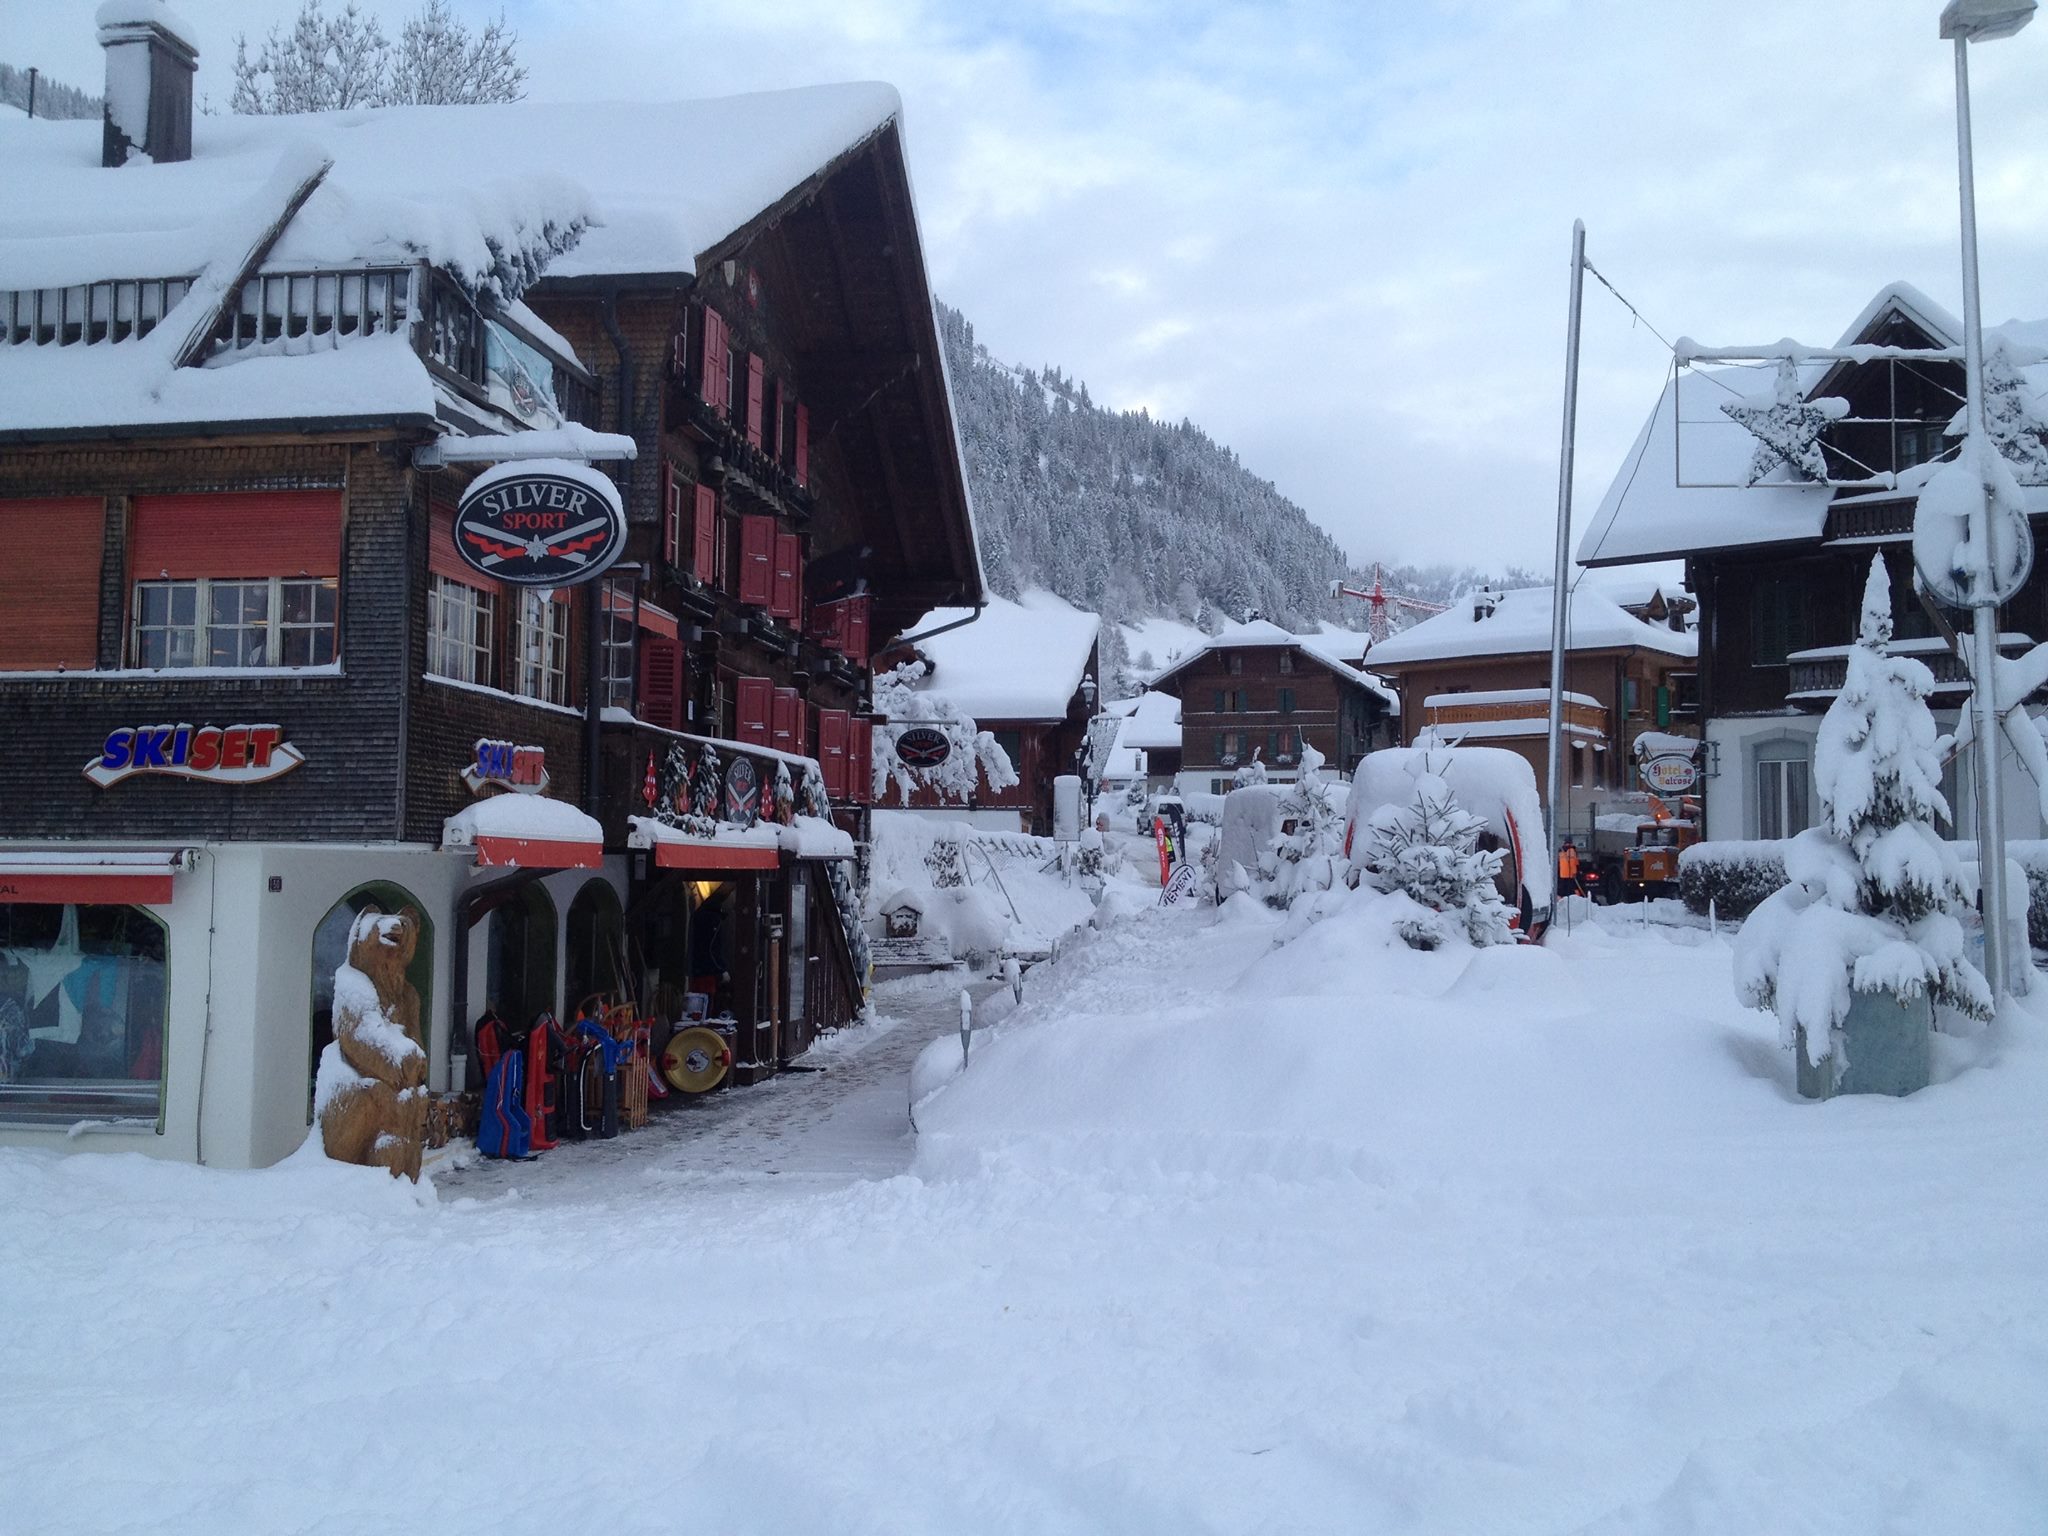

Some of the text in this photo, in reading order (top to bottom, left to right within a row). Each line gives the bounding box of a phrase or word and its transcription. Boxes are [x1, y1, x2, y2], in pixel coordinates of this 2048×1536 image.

[482, 484, 588, 518] SILVER
[503, 512, 568, 530] SPORT
[905, 731, 942, 744] SILVER
[101, 728, 277, 770] SKISET
[1652, 763, 1682, 777] Hotel
[0, 884, 19, 895] AL
